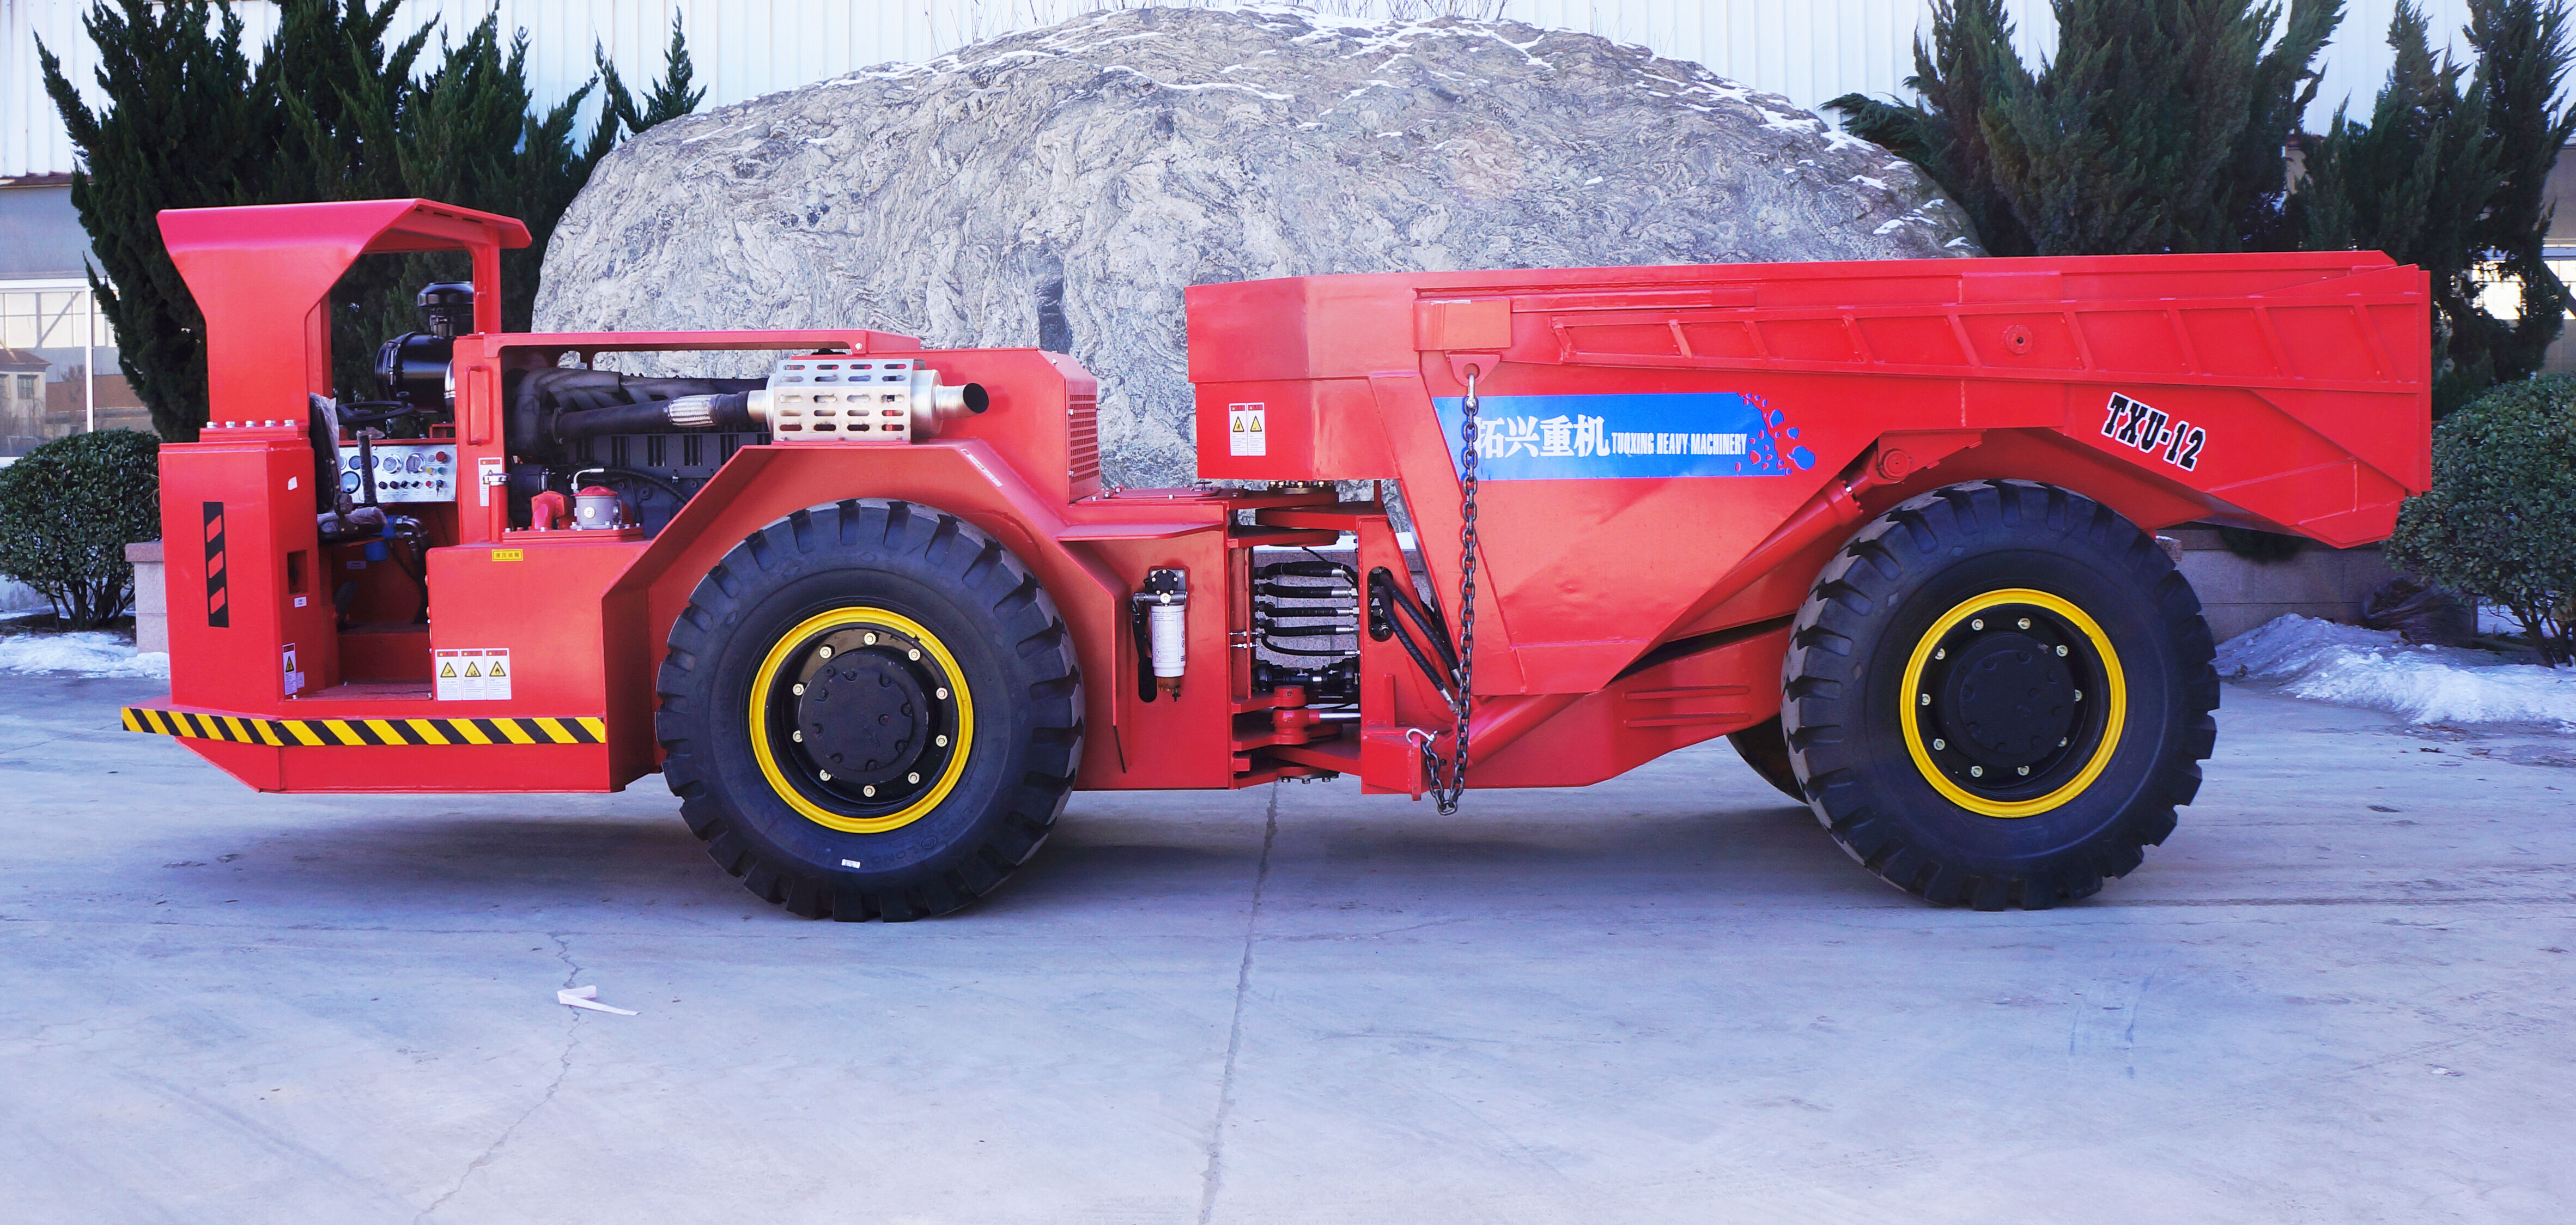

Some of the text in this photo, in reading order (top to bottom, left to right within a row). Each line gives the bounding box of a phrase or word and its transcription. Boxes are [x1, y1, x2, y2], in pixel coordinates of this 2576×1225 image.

[1472, 414, 1610, 458] 拓兴重机
[1611, 432, 1747, 455] TUOXING HEAVY MACHINERY
[2101, 392, 2206, 471] TXU-12
